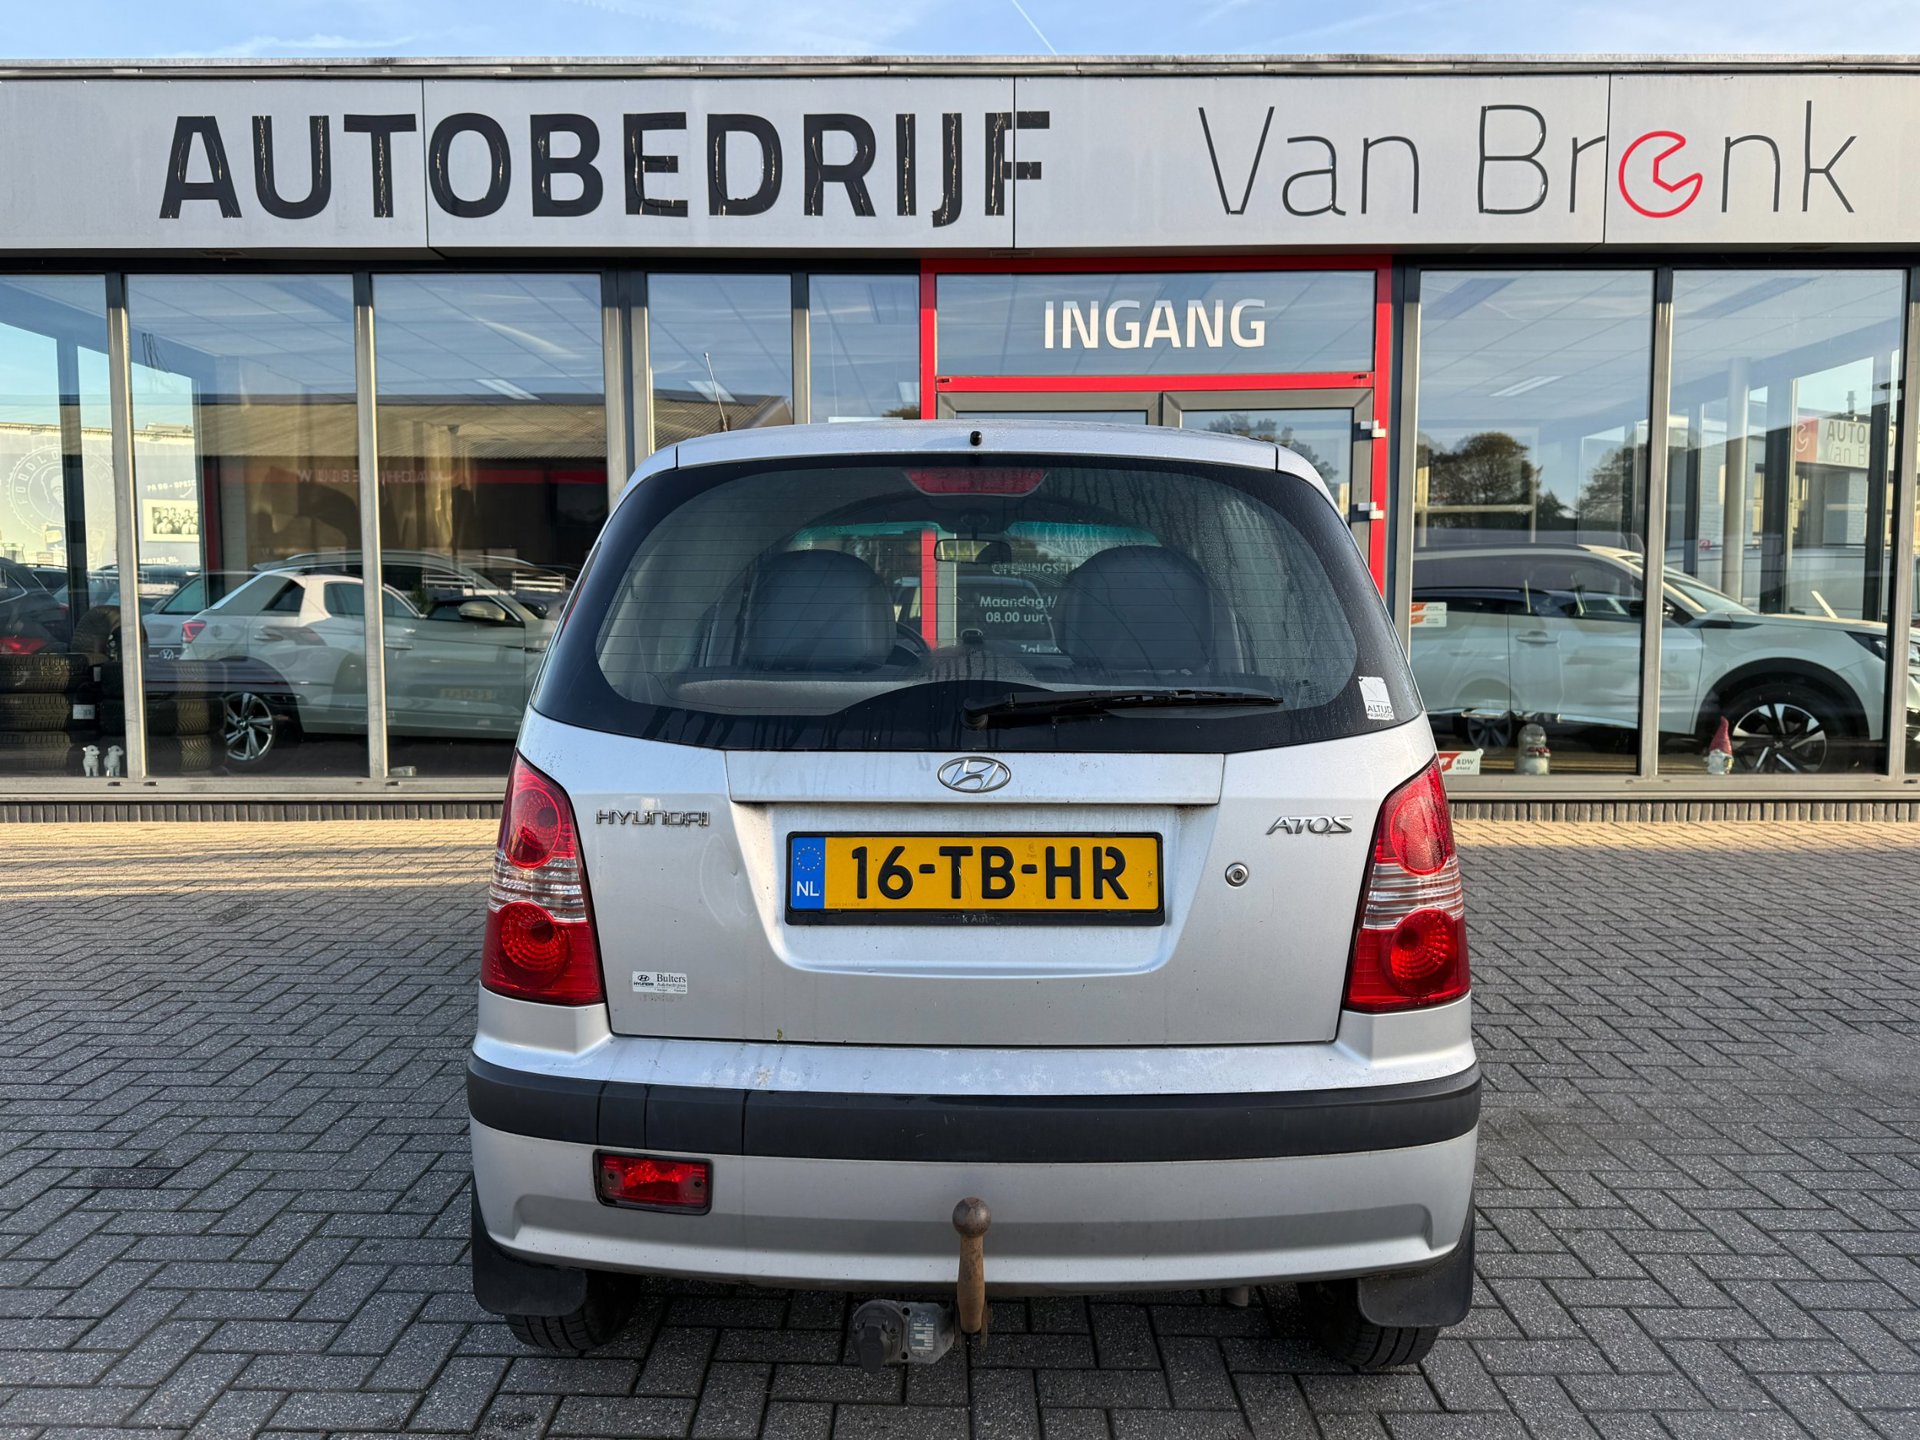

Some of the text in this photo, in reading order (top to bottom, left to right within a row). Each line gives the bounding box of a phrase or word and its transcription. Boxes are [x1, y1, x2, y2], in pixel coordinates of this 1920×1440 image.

[158, 111, 1050, 228] AUTOBEDRIJF
[1199, 105, 1421, 218] Van
[1044, 298, 1267, 350] INGANG
[980, 595, 1044, 609] Maandag
[985, 611, 1020, 623] 08.00
[595, 810, 711, 826] HYUNDAI
[1265, 815, 1353, 836] ATOS
[851, 845, 1129, 900] 16-TB-HR
[796, 880, 820, 897] NL
[656, 973, 687, 983] Bulters
